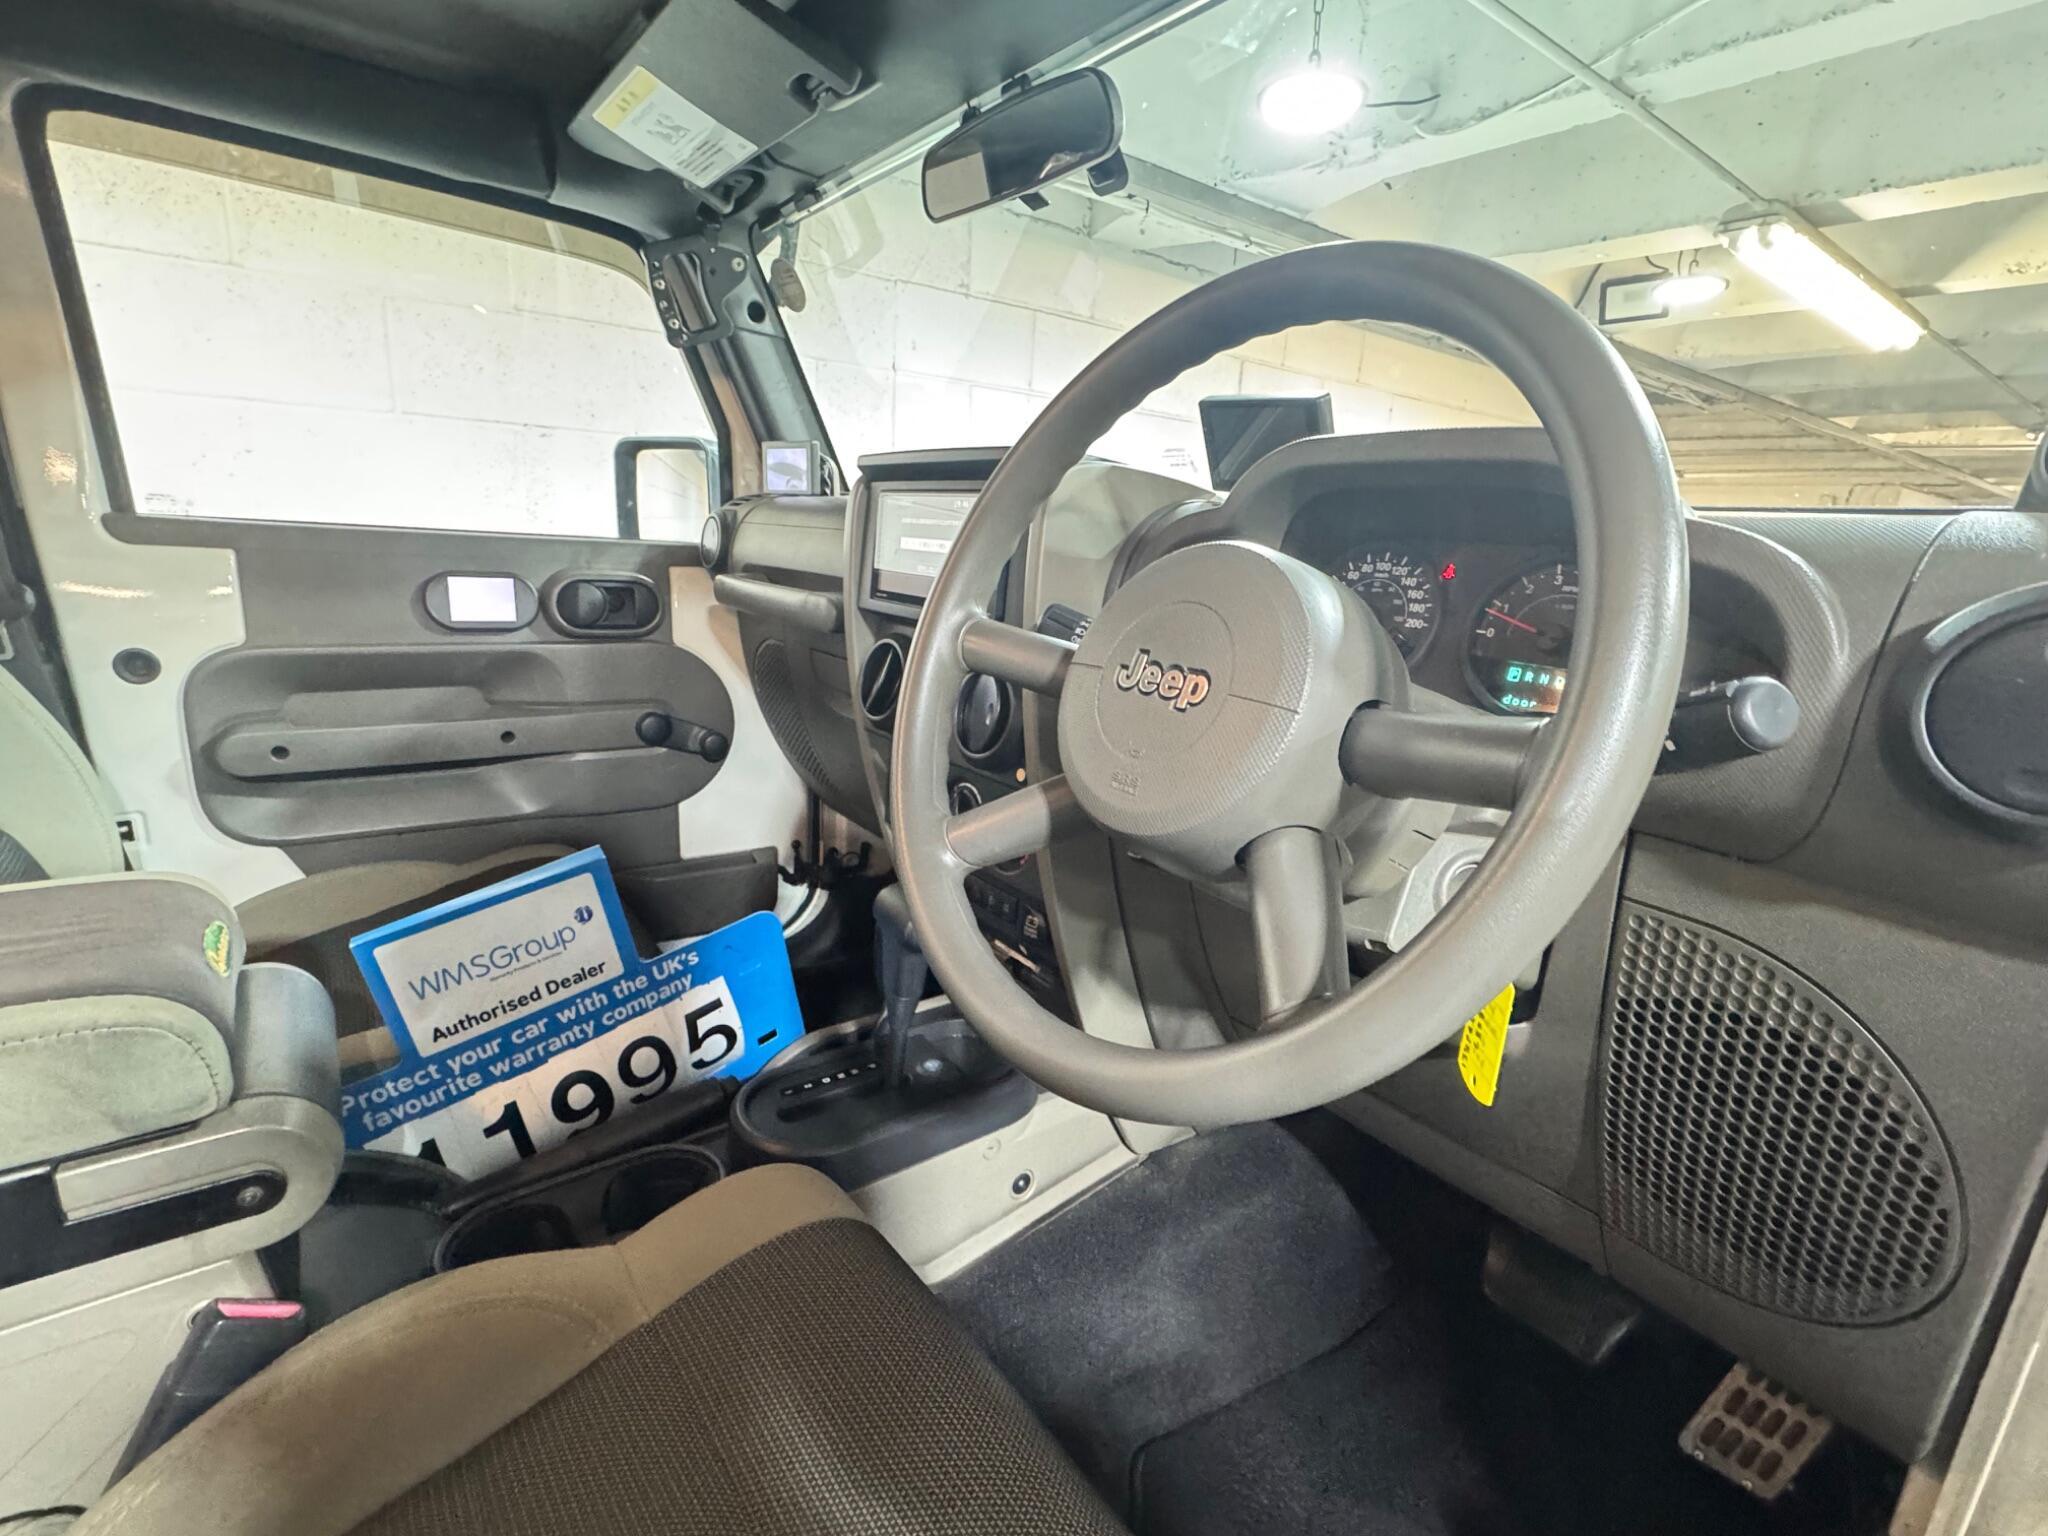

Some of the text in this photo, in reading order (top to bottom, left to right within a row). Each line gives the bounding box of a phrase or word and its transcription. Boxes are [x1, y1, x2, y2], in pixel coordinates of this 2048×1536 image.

[1361, 563, 1374, 573] 80
[1375, 562, 1392, 571] 100
[1391, 566, 1408, 576] 120
[1400, 577, 1417, 587] 140
[1553, 575, 1564, 586] 3
[1407, 589, 1424, 600] 160
[1525, 583, 1535, 595] 2
[1408, 602, 1425, 613] 180
[1404, 618, 1424, 629] 200
[1117, 649, 1211, 712] Jeep
[1525, 671, 1534, 683] R
[1502, 694, 1537, 708] door
[408, 925, 576, 1000] WMSGroup
[432, 985, 542, 1043] Authorised
[545, 961, 607, 996] Dealer
[342, 951, 700, 1117] Protect your car with the UK's
[362, 972, 693, 1132] favourite warranty company
